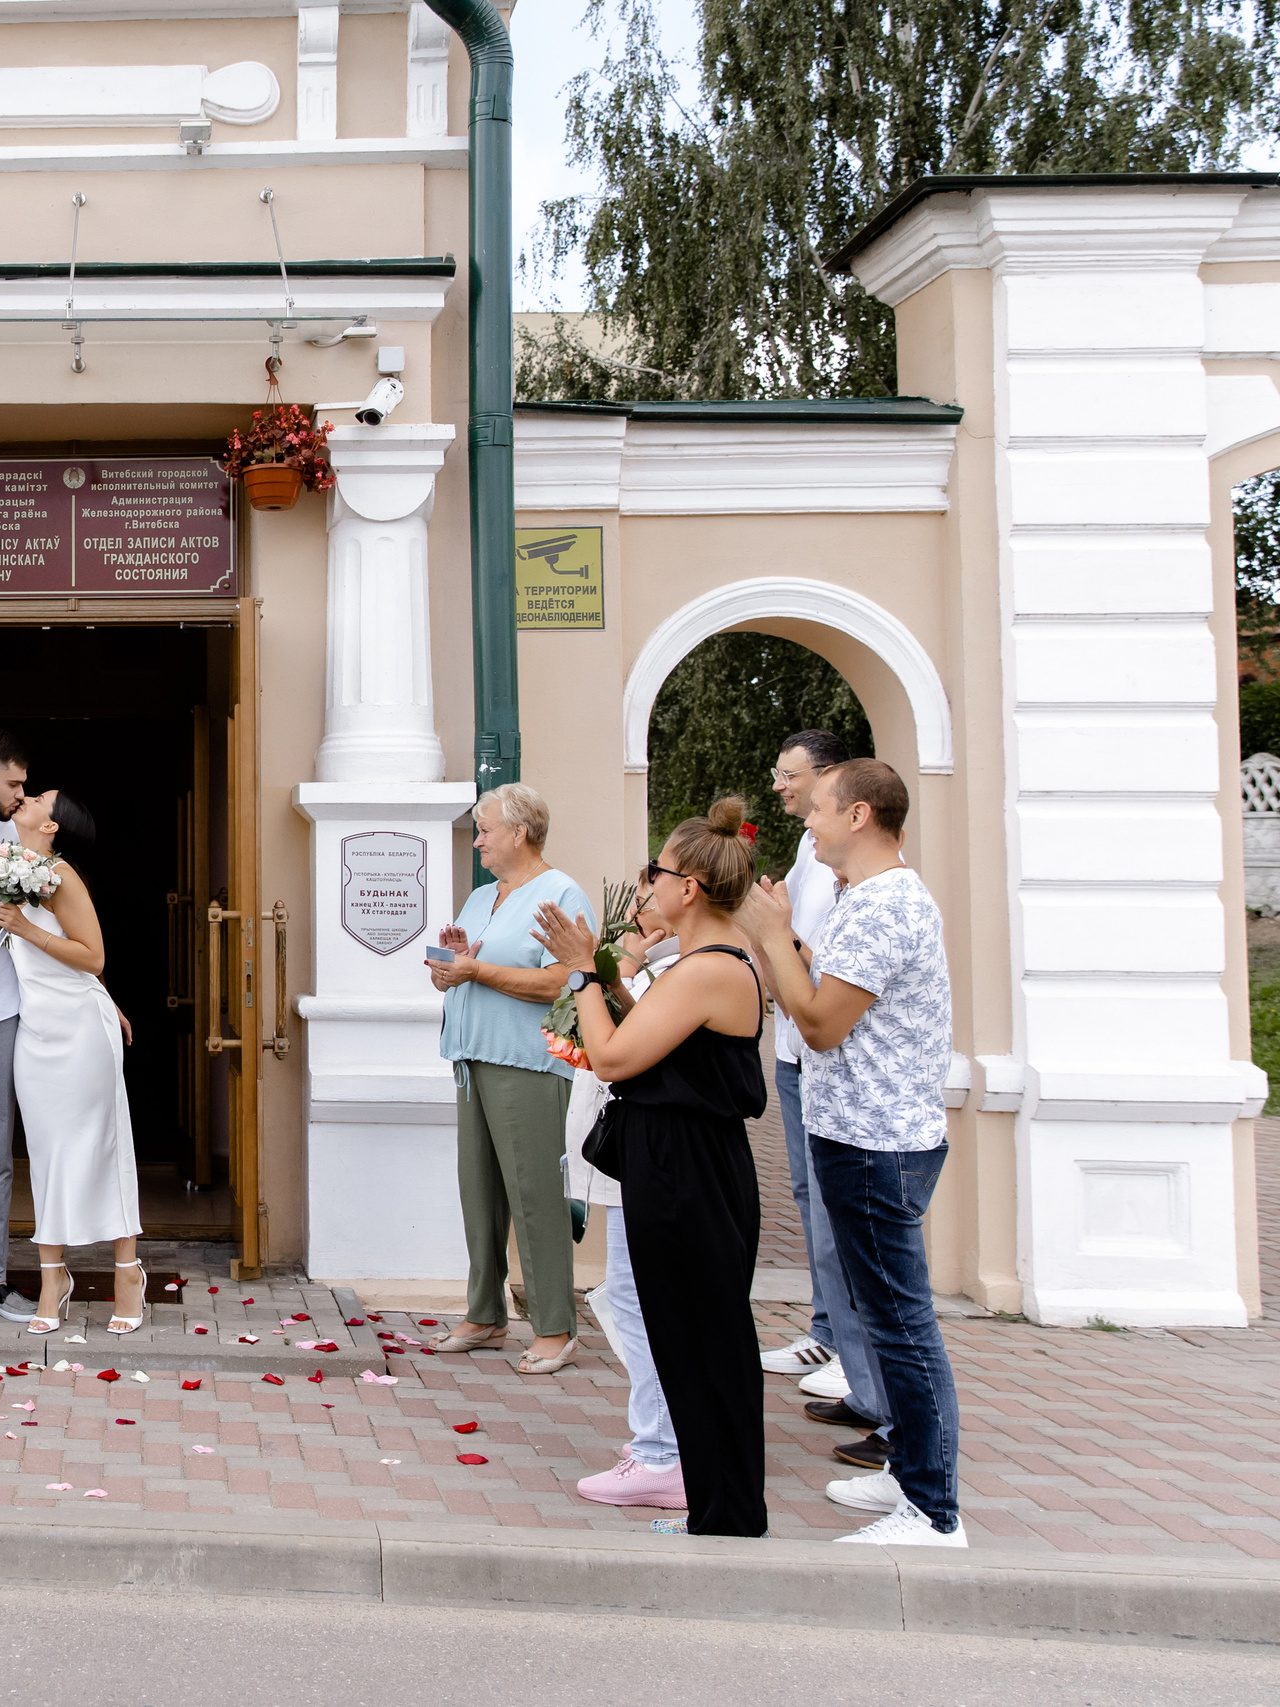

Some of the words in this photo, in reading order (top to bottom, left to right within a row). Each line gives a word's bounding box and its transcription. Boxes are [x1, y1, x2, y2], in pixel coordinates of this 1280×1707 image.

[101, 468, 153, 479] Витебский
[157, 468, 208, 479] городской
[5, 483, 48, 491] камітэт
[91, 481, 175, 490] исполнительный
[111, 496, 193, 506] Администрация
[14, 510, 47, 520] раёна
[82, 508, 182, 518] Железнодорожного
[186, 506, 222, 518] района
[124, 519, 179, 529] г.Витебска
[25, 535, 60, 550] АКТАЎ
[83, 538, 122, 551] ОТДЕЛ
[127, 537, 175, 549] ЗАПИСИ
[180, 536, 219, 548] АКТОВ
[104, 553, 199, 566] ГРАЖДАНСКОГО
[115, 568, 188, 580] СОСТОЯНИЯ
[524, 586, 597, 596] ТЕРРИТОРИИ
[527, 598, 574, 610] ВЕДЁТСЯ
[516, 612, 600, 623] ДЕОНАБЛЮДЕНИЕ
